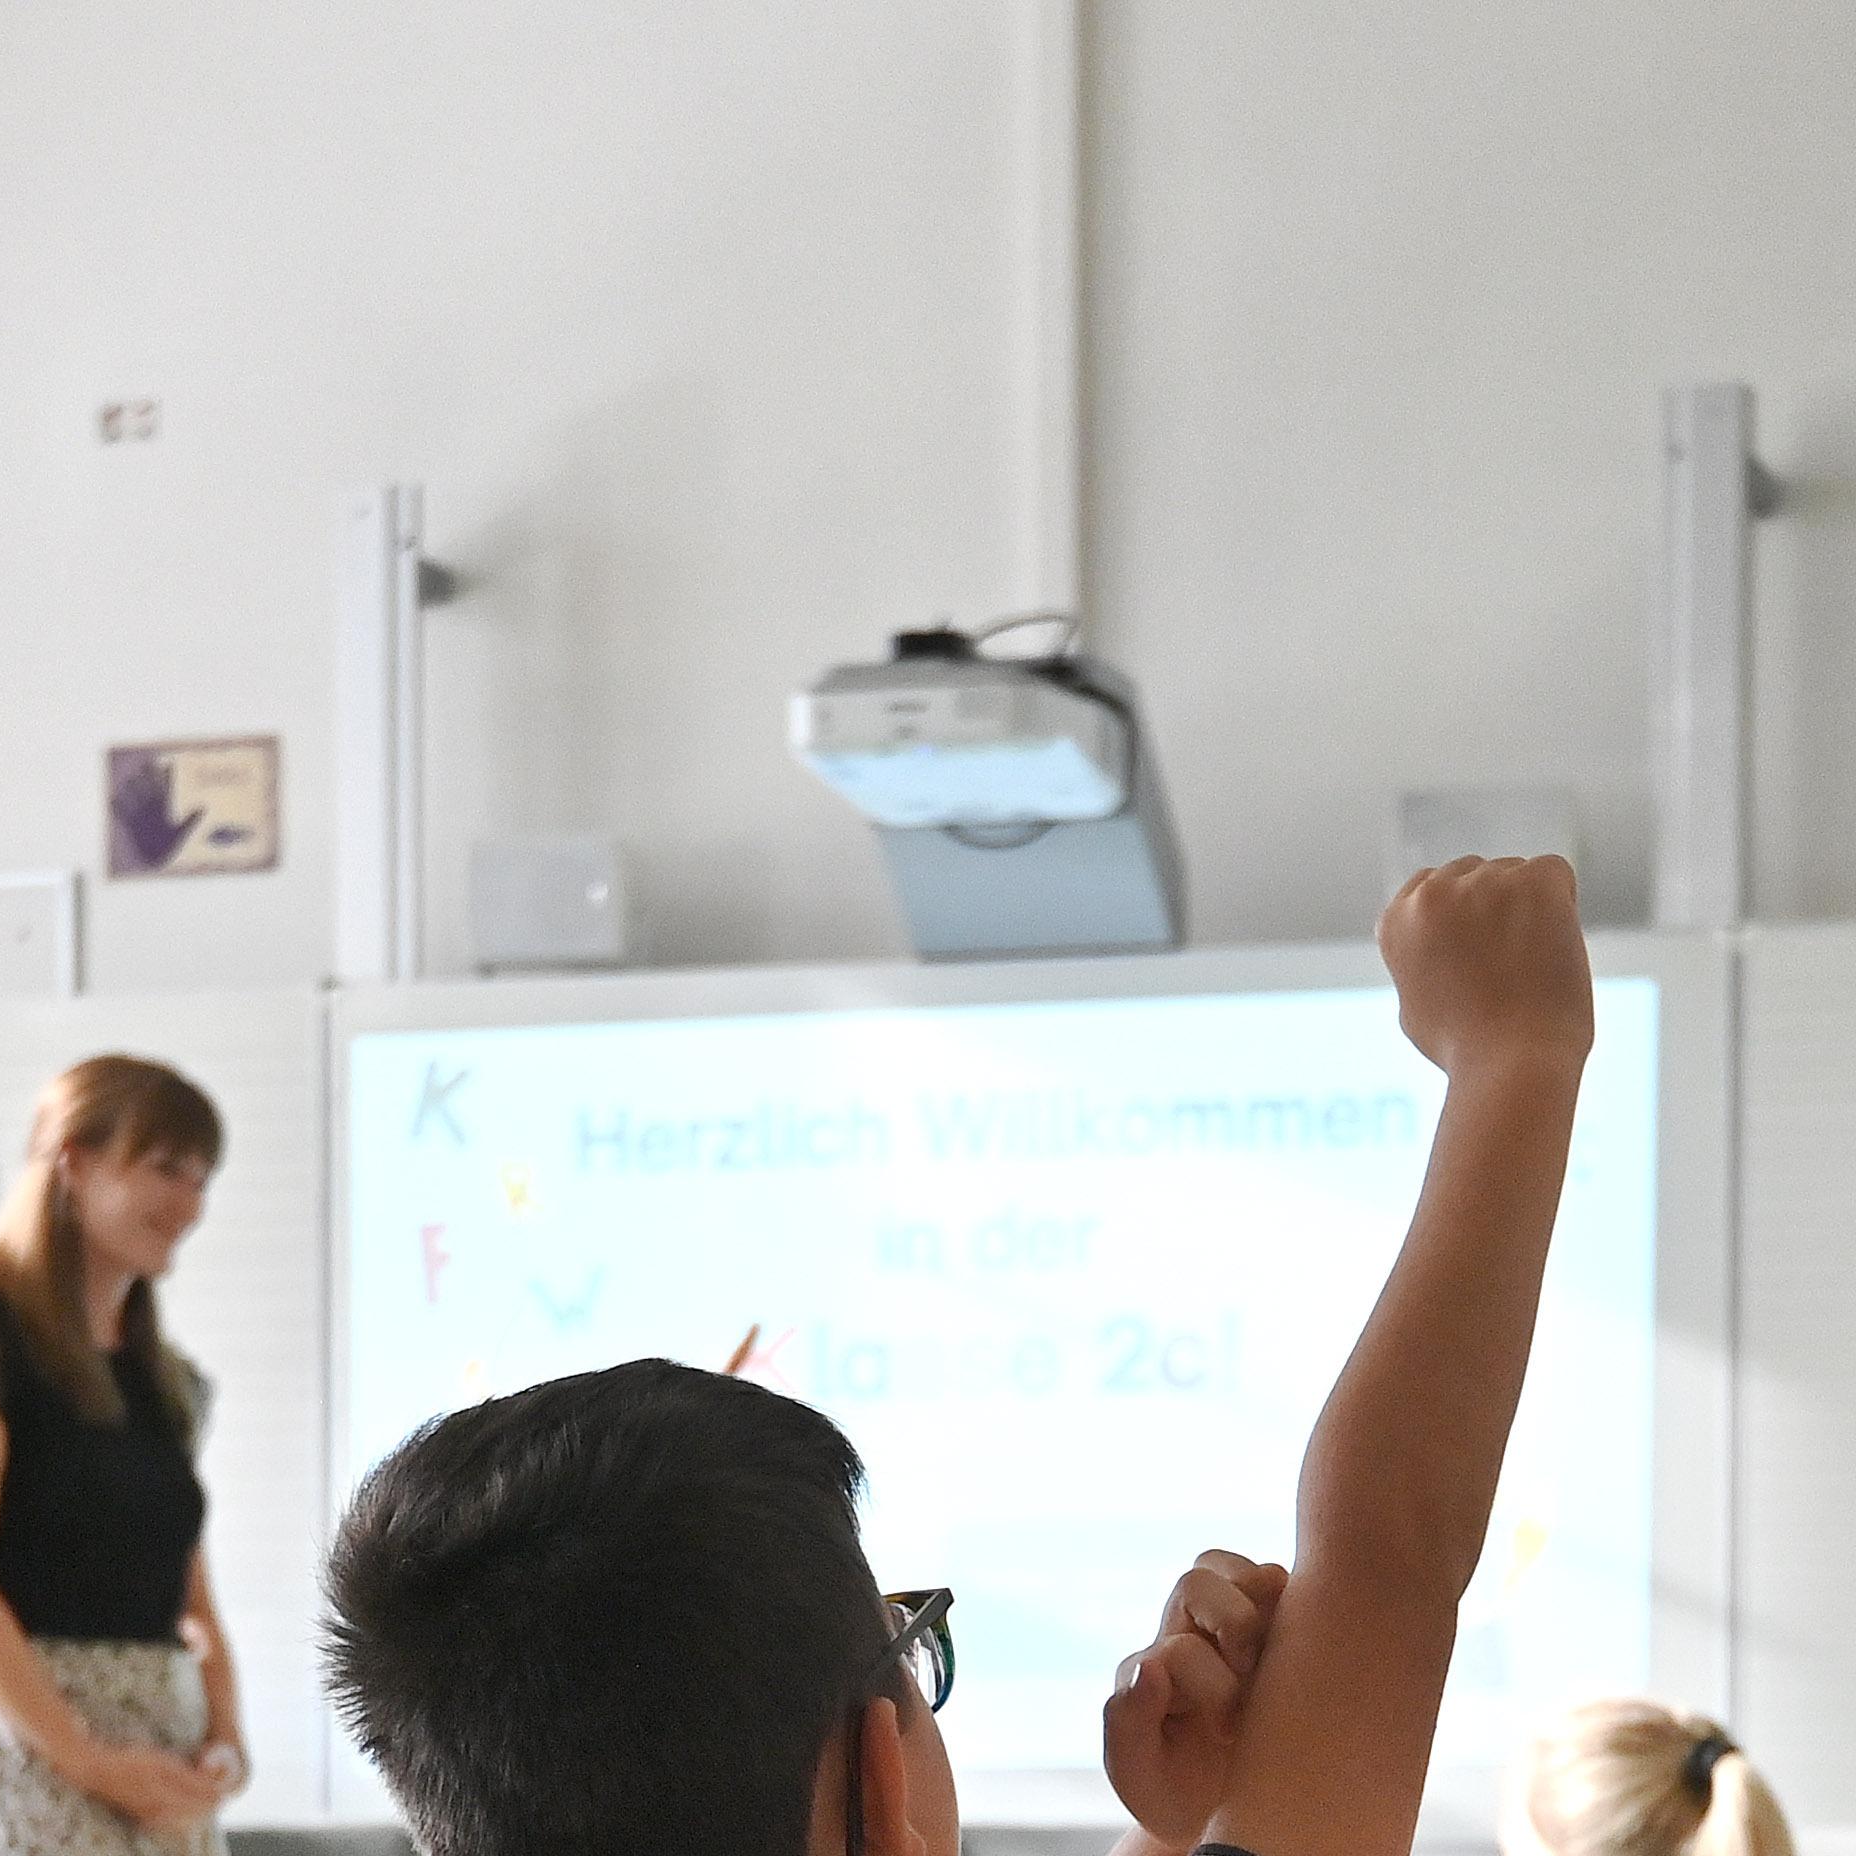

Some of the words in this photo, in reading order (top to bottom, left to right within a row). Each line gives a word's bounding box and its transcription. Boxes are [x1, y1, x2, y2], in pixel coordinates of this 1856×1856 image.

[410, 1060, 473, 1147] K
[575, 1099, 890, 1174] Herzlich
[917, 1090, 1421, 1160] Willkommen
[875, 1210, 947, 1276] in
[970, 1205, 1100, 1273] der
[1097, 1308, 1242, 1396] 2c!
